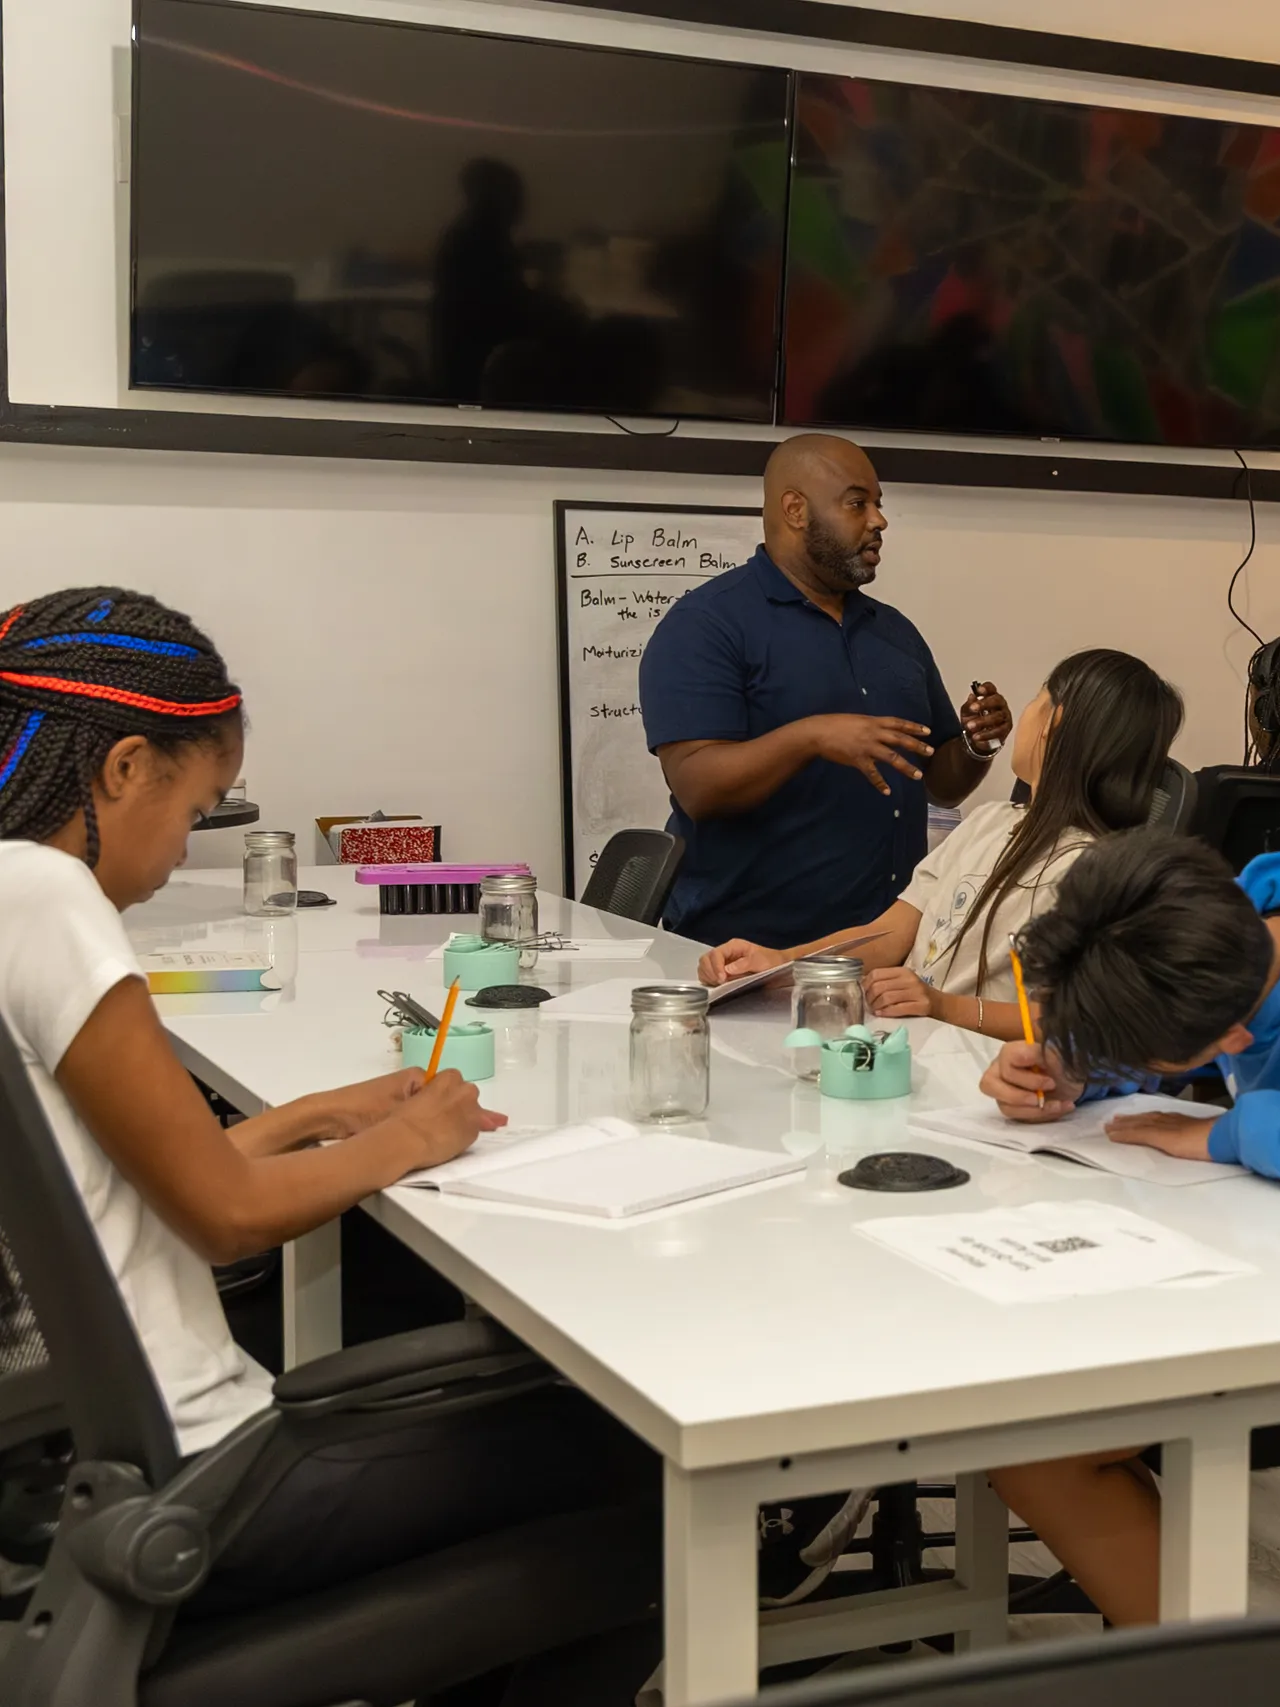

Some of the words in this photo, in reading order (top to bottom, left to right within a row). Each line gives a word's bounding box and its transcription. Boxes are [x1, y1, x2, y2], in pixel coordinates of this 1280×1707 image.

[575, 526, 594, 546] A.
[611, 529, 635, 553] Lip
[652, 527, 698, 549] Balm
[576, 552, 590, 568] B.
[610, 556, 685, 569] Sunscreen
[699, 552, 737, 569] Balm
[617, 607, 638, 621] the
[648, 607, 661, 618] is
